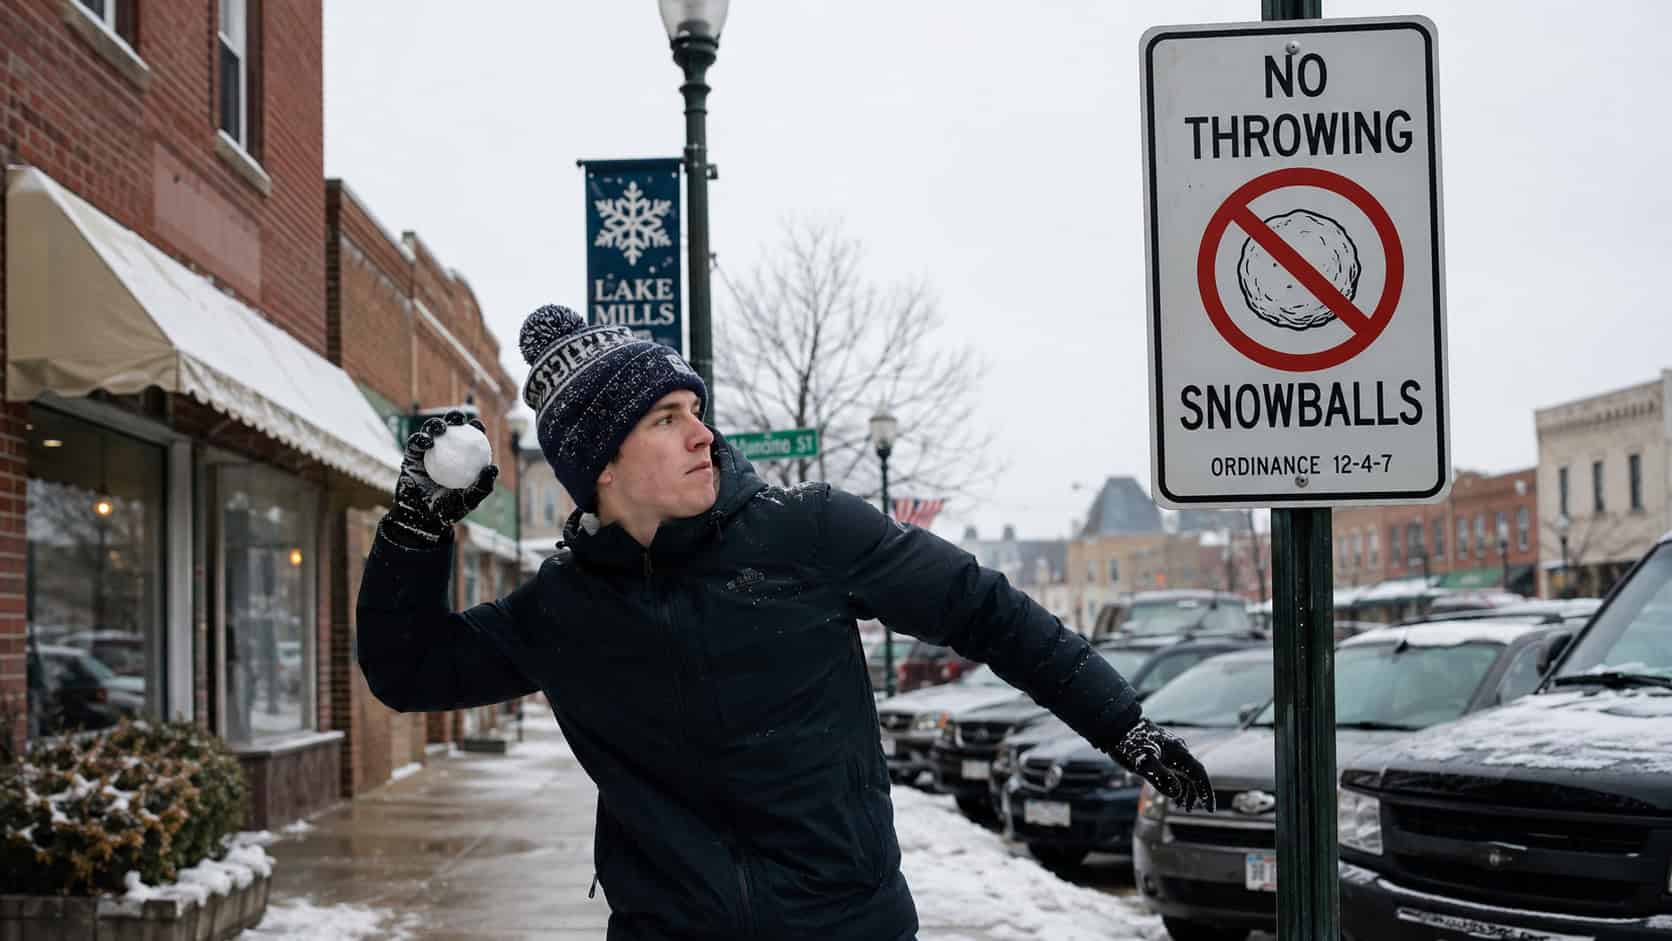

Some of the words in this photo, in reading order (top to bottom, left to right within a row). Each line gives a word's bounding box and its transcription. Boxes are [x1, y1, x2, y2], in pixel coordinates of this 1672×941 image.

[1264, 53, 1328, 98] NO
[1184, 109, 1414, 160] THROWING
[594, 278, 674, 301] LAKE
[594, 303, 675, 326] MILLS
[1179, 380, 1424, 430] SNOWBALLS
[1211, 456, 1321, 477] ORDINANCE
[1333, 455, 1393, 474] 12-4-7
